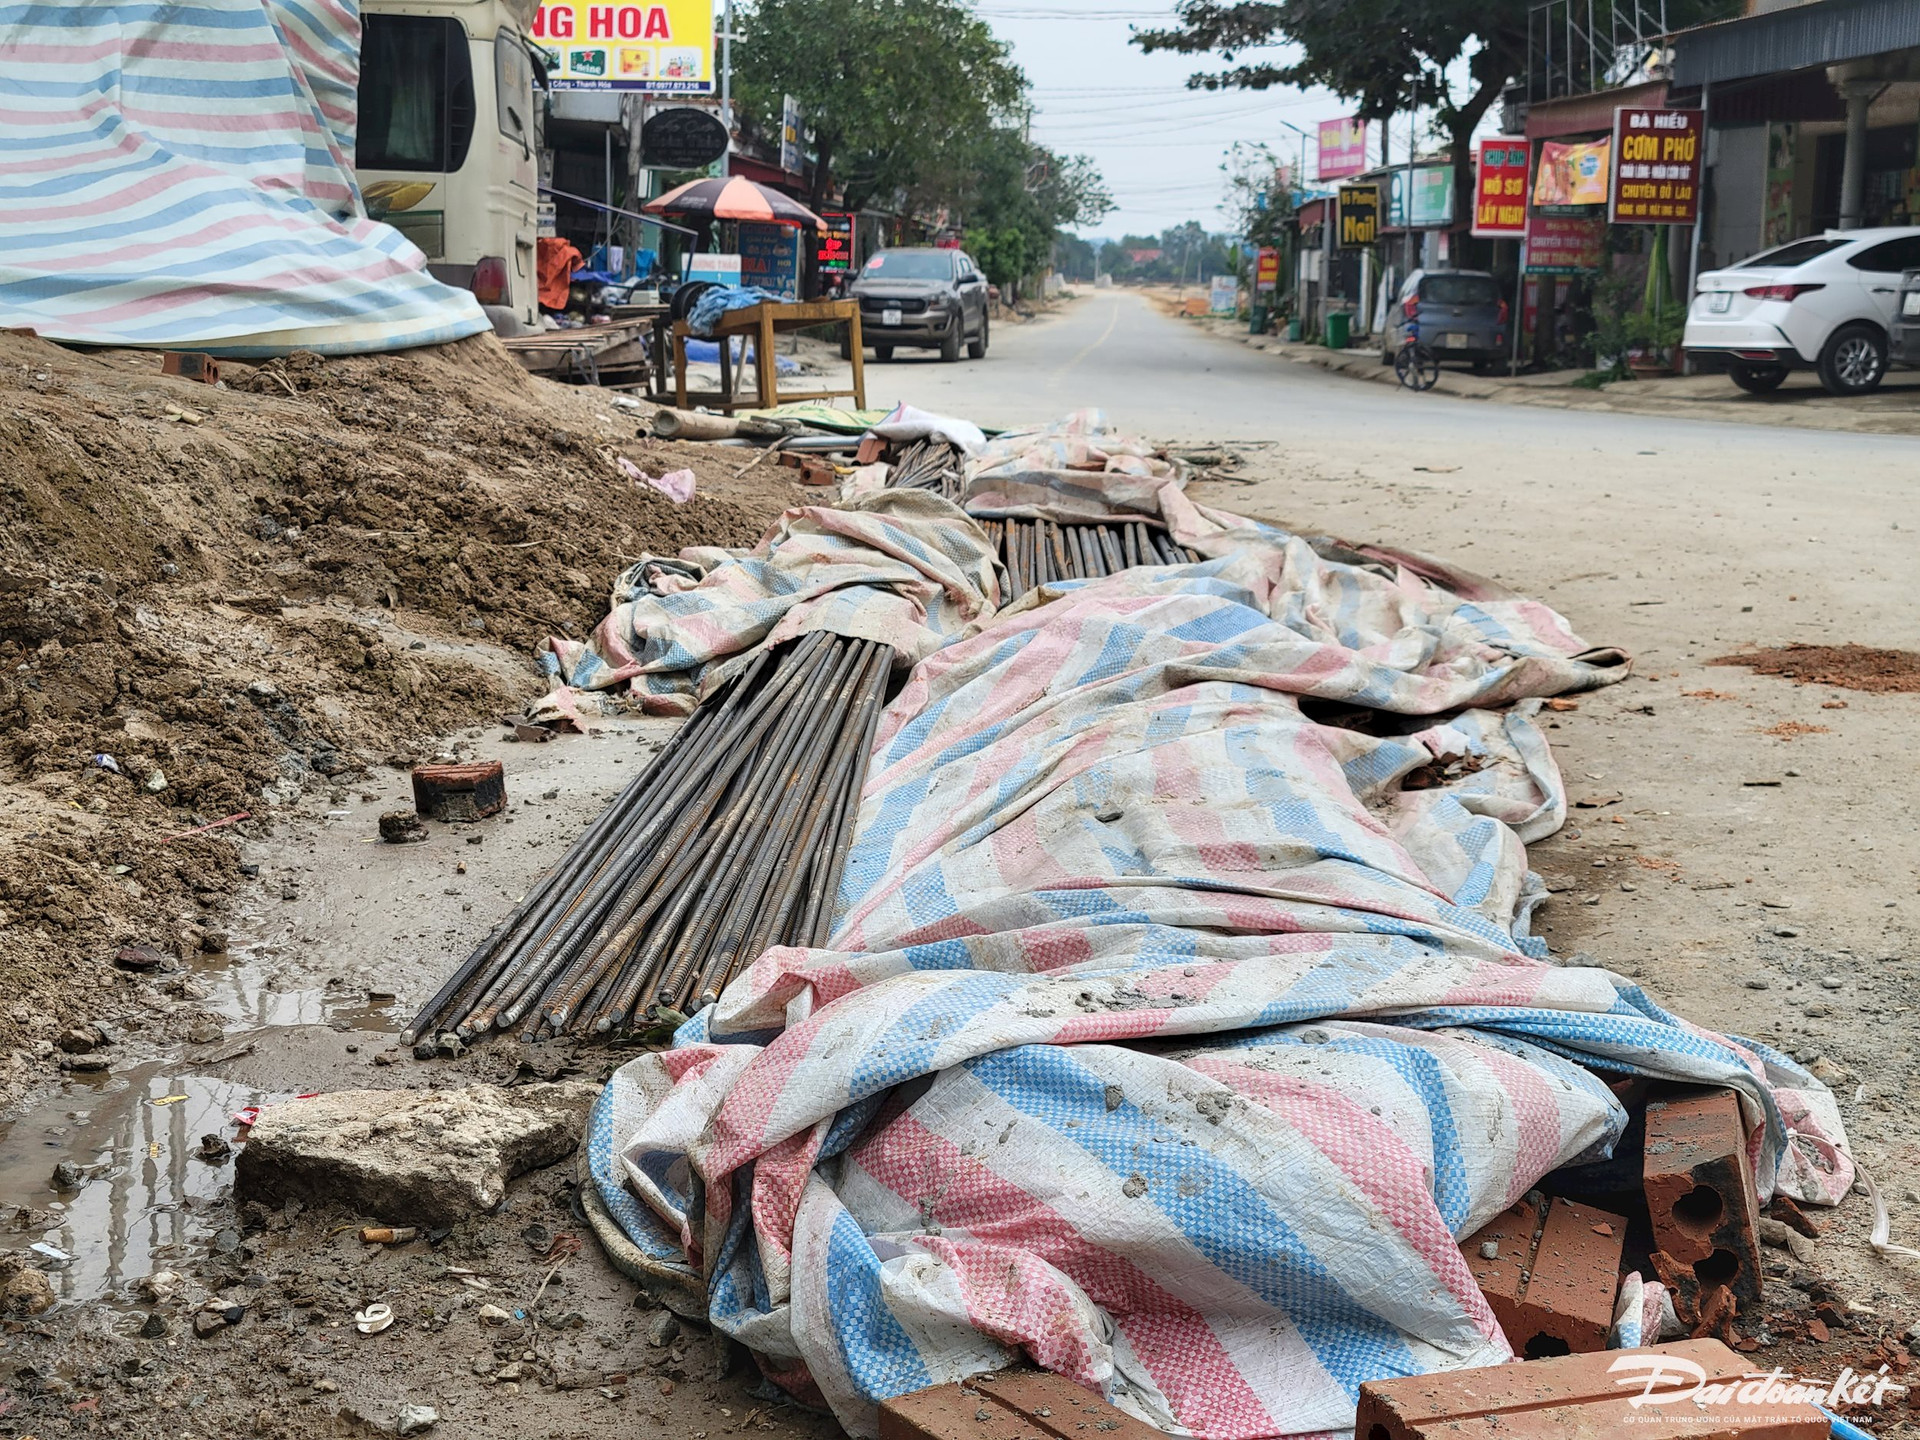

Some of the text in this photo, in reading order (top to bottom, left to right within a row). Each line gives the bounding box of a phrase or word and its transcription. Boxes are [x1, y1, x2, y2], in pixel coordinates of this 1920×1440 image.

[590, 7, 669, 38] HOA
[576, 81, 597, 89] Thanh
[1630, 112, 1650, 128] BÀ
[1623, 129, 1696, 162] CƠM PHỞ
[1622, 183, 1656, 198] CHUYÊN
[1498, 205, 1526, 225] NGAY
[1344, 215, 1375, 243] Nail
